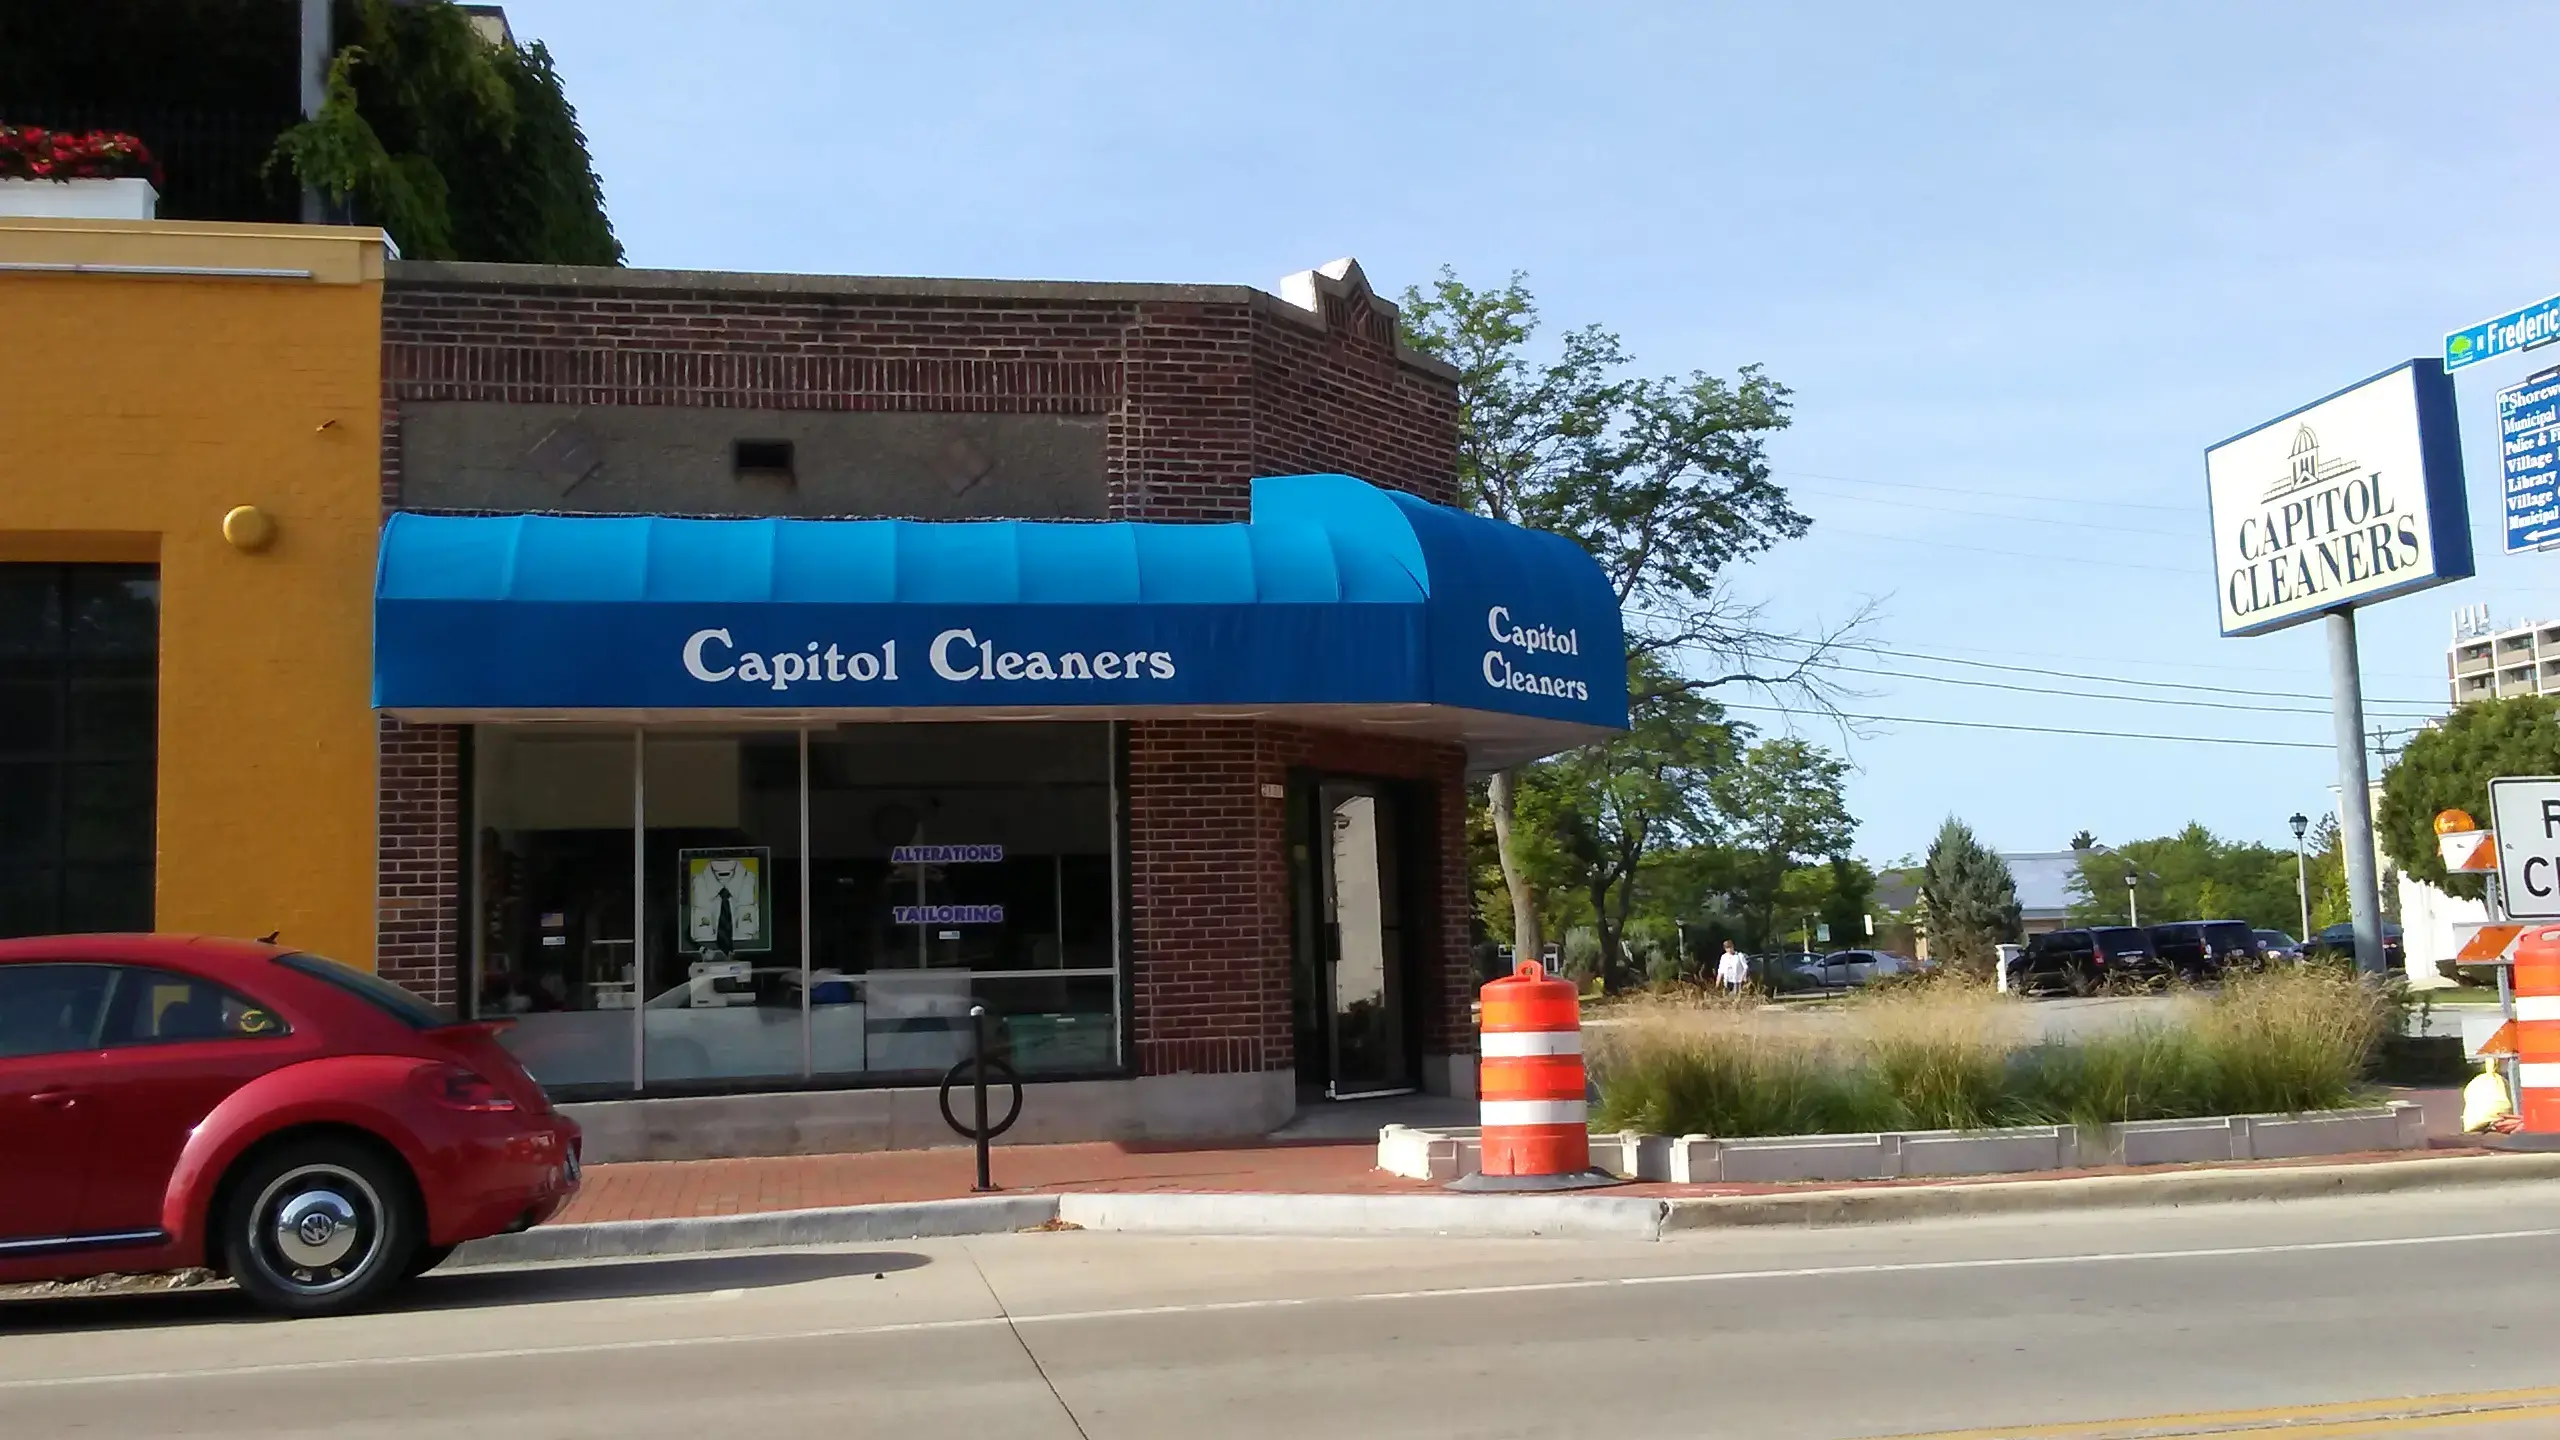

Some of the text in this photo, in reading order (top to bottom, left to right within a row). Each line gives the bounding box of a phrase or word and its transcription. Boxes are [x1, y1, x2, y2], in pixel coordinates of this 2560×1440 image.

[2509, 384, 2560, 410] Shorew
[2504, 404, 2556, 435] Municipal
[2505, 437, 2535, 456] Police
[2506, 453, 2553, 473] Village
[2507, 470, 2557, 493] Library
[2508, 491, 2553, 511] Village
[2239, 471, 2395, 561] CAPITOL
[2508, 505, 2559, 530] Municipal
[2229, 513, 2420, 616] CLEANERS
[1488, 605, 1578, 656] Capitol
[683, 627, 1176, 691] Capitol Cleaners
[1482, 650, 1588, 701] Cleaners
[891, 844, 1004, 863] ALTERATIONS
[2524, 856, 2560, 897] C
[892, 905, 1004, 924] TAILORING
